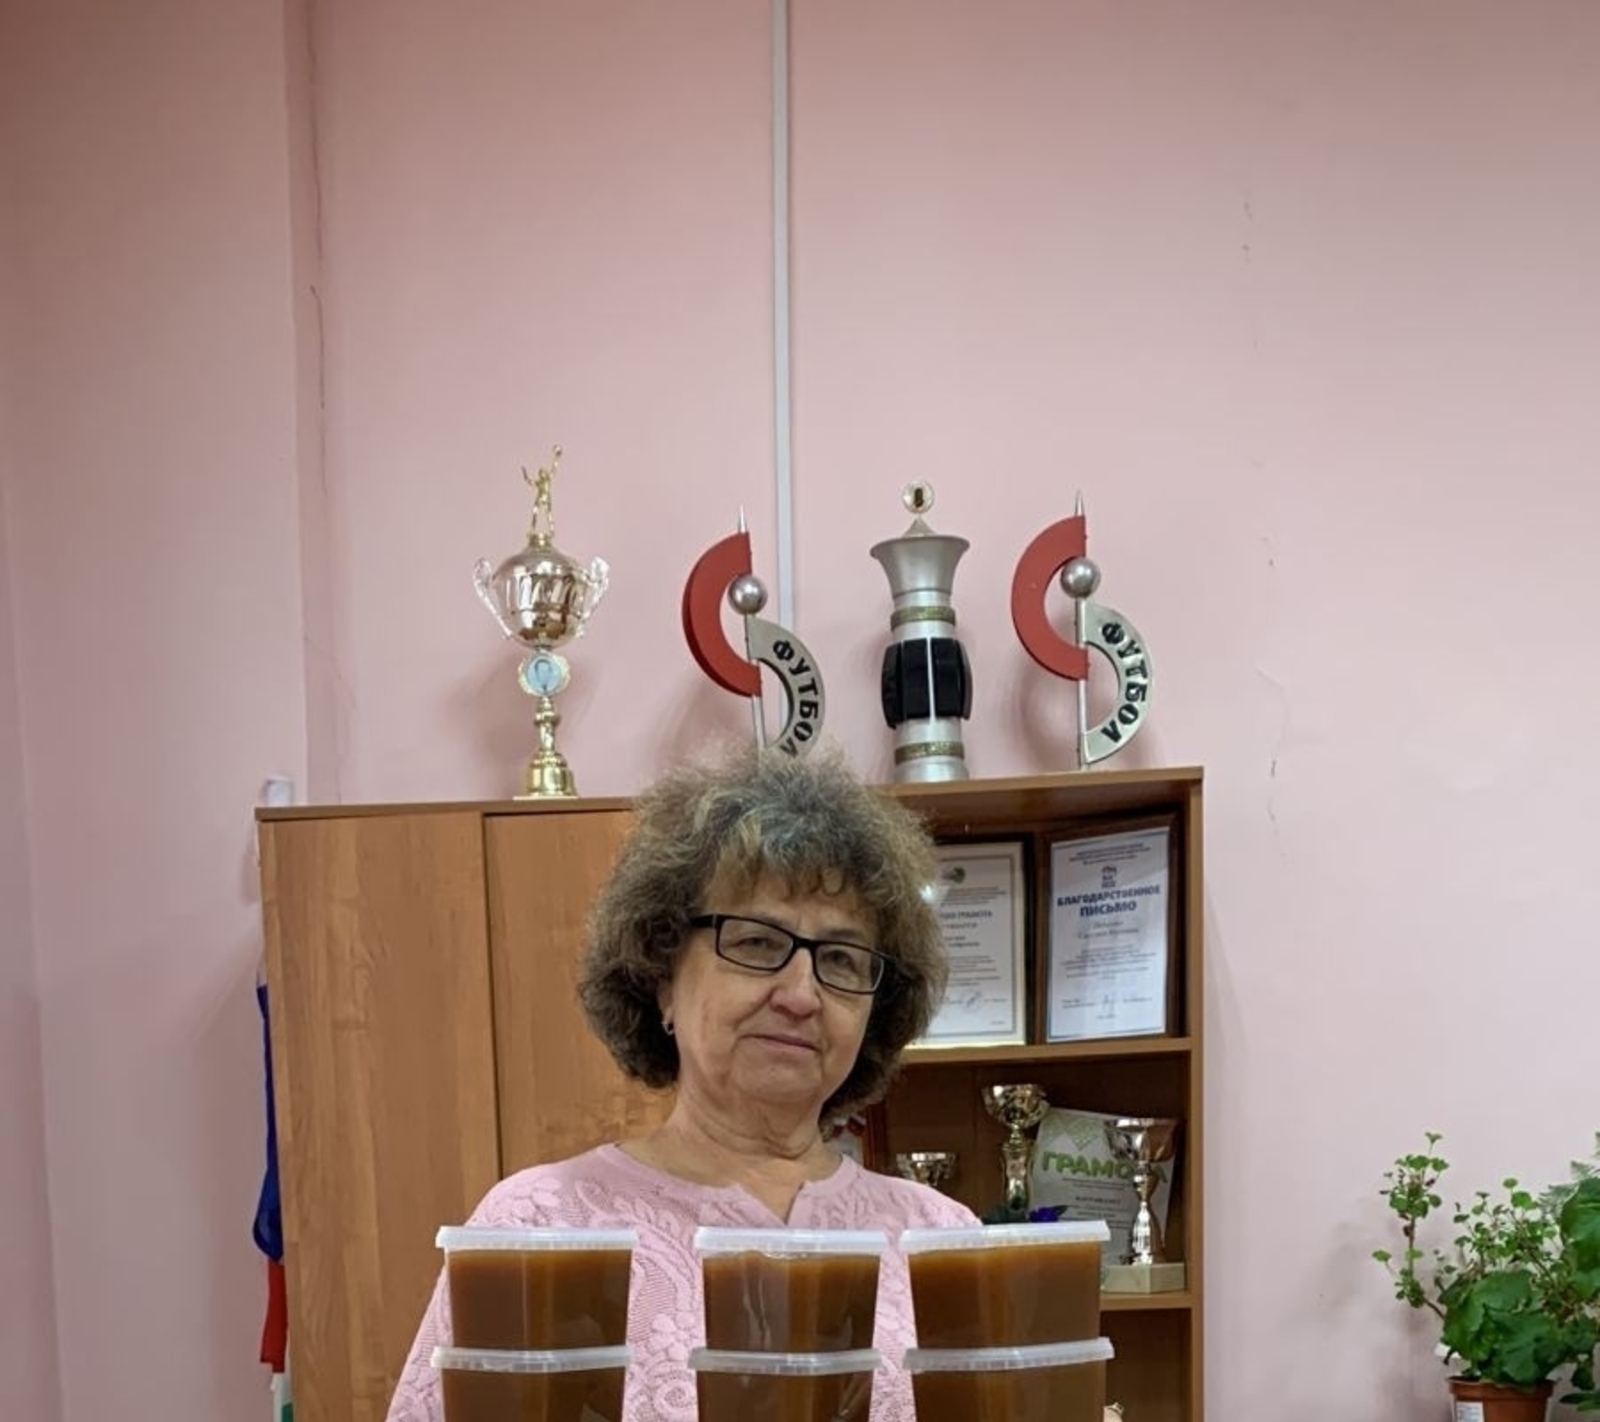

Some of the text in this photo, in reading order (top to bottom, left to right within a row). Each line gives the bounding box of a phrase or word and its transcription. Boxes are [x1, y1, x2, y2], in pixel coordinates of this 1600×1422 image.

[1101, 622, 1148, 743] ФУТБОЛ
[773, 640, 819, 759] ФУТБОЛ
[1057, 884, 1161, 907] БЛАГОДАРСТВЕННОЕ
[1080, 901, 1137, 917] ПИСЬМО
[1042, 1151, 1168, 1184] ГРАМОА
